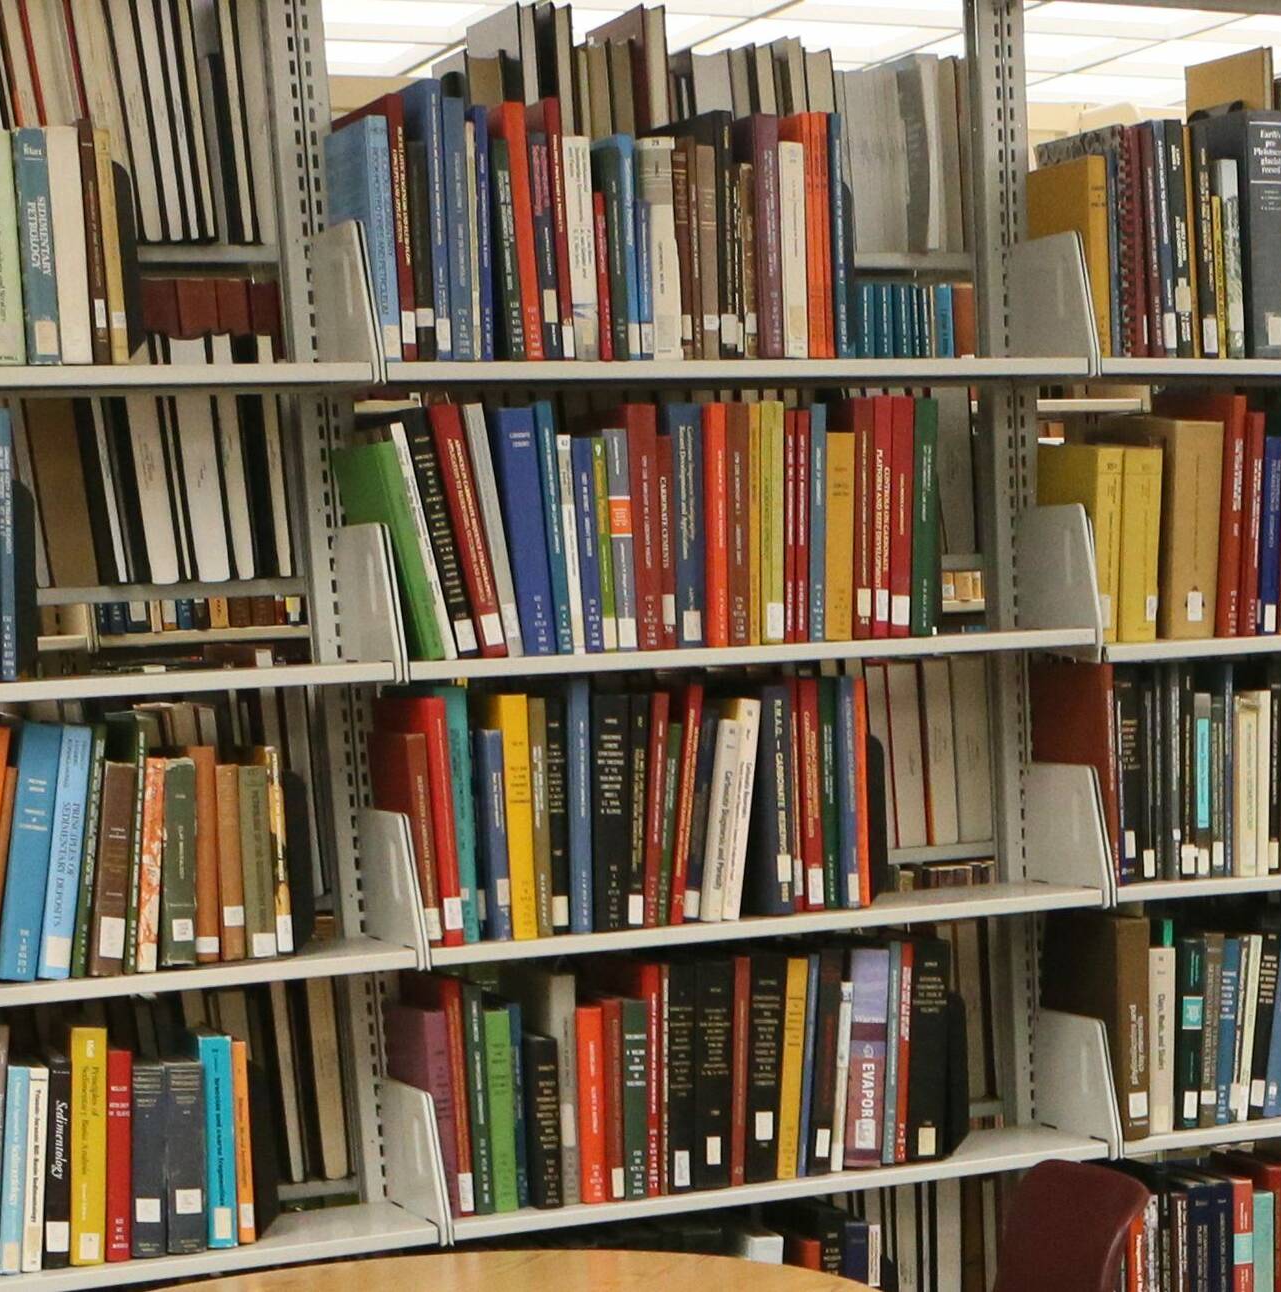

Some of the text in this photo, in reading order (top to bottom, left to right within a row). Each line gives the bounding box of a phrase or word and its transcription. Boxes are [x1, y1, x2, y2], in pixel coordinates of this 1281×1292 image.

[27, 201, 41, 269] PETROLOGY
[37, 196, 52, 275] SEDIMENTARY
[775, 752, 785, 808] CARBONATE
[68, 802, 80, 859] PRINCIPLES
[779, 810, 788, 855] RESERVO
[52, 801, 70, 926] SEDIMENTARY DEPOSITS
[862, 1063, 875, 1119] EVAPOR
[51, 1100, 68, 1179] Sedimentology
